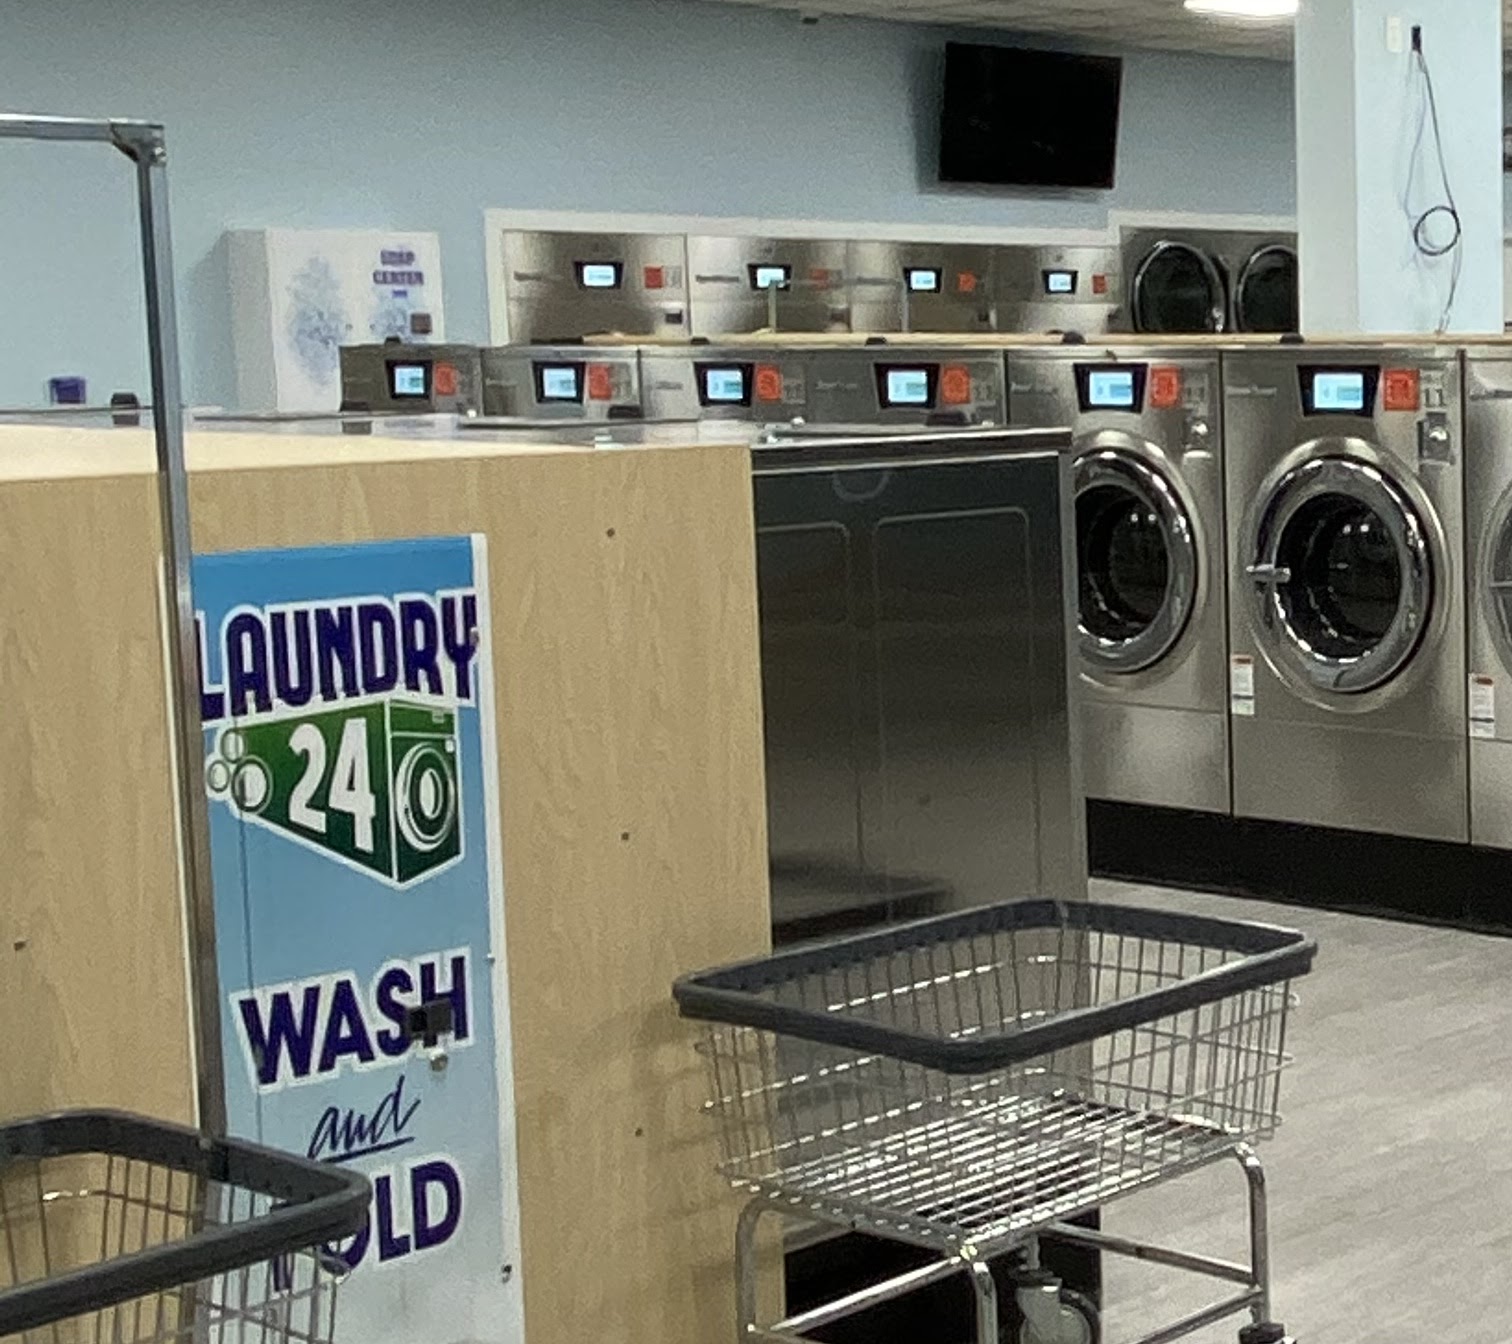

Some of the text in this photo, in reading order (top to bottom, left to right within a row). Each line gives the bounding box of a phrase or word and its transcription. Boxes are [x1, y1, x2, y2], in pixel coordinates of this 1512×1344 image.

[195, 594, 477, 723] LAUNDRY
[289, 717, 376, 853] 24
[239, 955, 470, 1085] WASH
[307, 1074, 421, 1161] and
